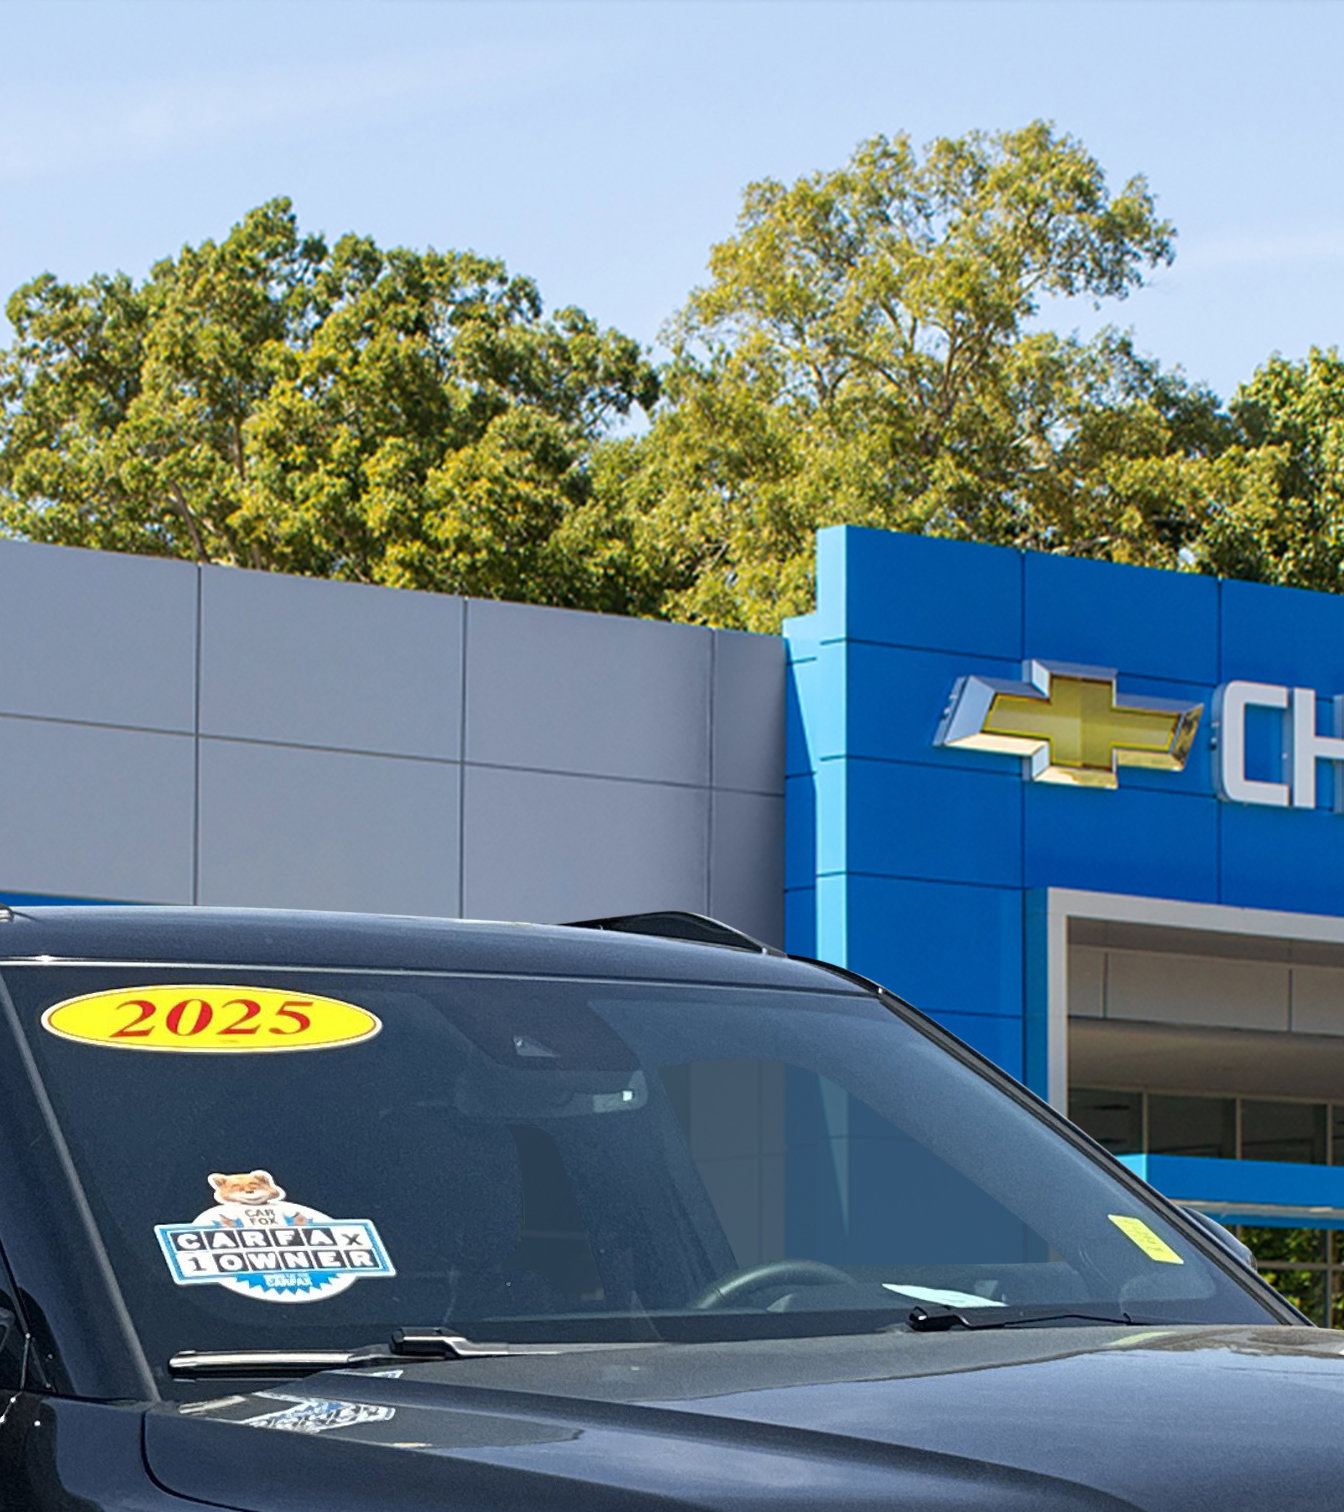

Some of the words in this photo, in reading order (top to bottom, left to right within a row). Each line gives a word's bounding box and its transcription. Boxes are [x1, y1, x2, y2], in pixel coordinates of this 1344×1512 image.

[108, 999, 314, 1038] 2025
[244, 1209, 276, 1218] CAR
[249, 1216, 279, 1226] FOX
[174, 1228, 362, 1250] CARFAX
[188, 1252, 208, 1272] 1
[218, 1250, 375, 1272] OWNER
